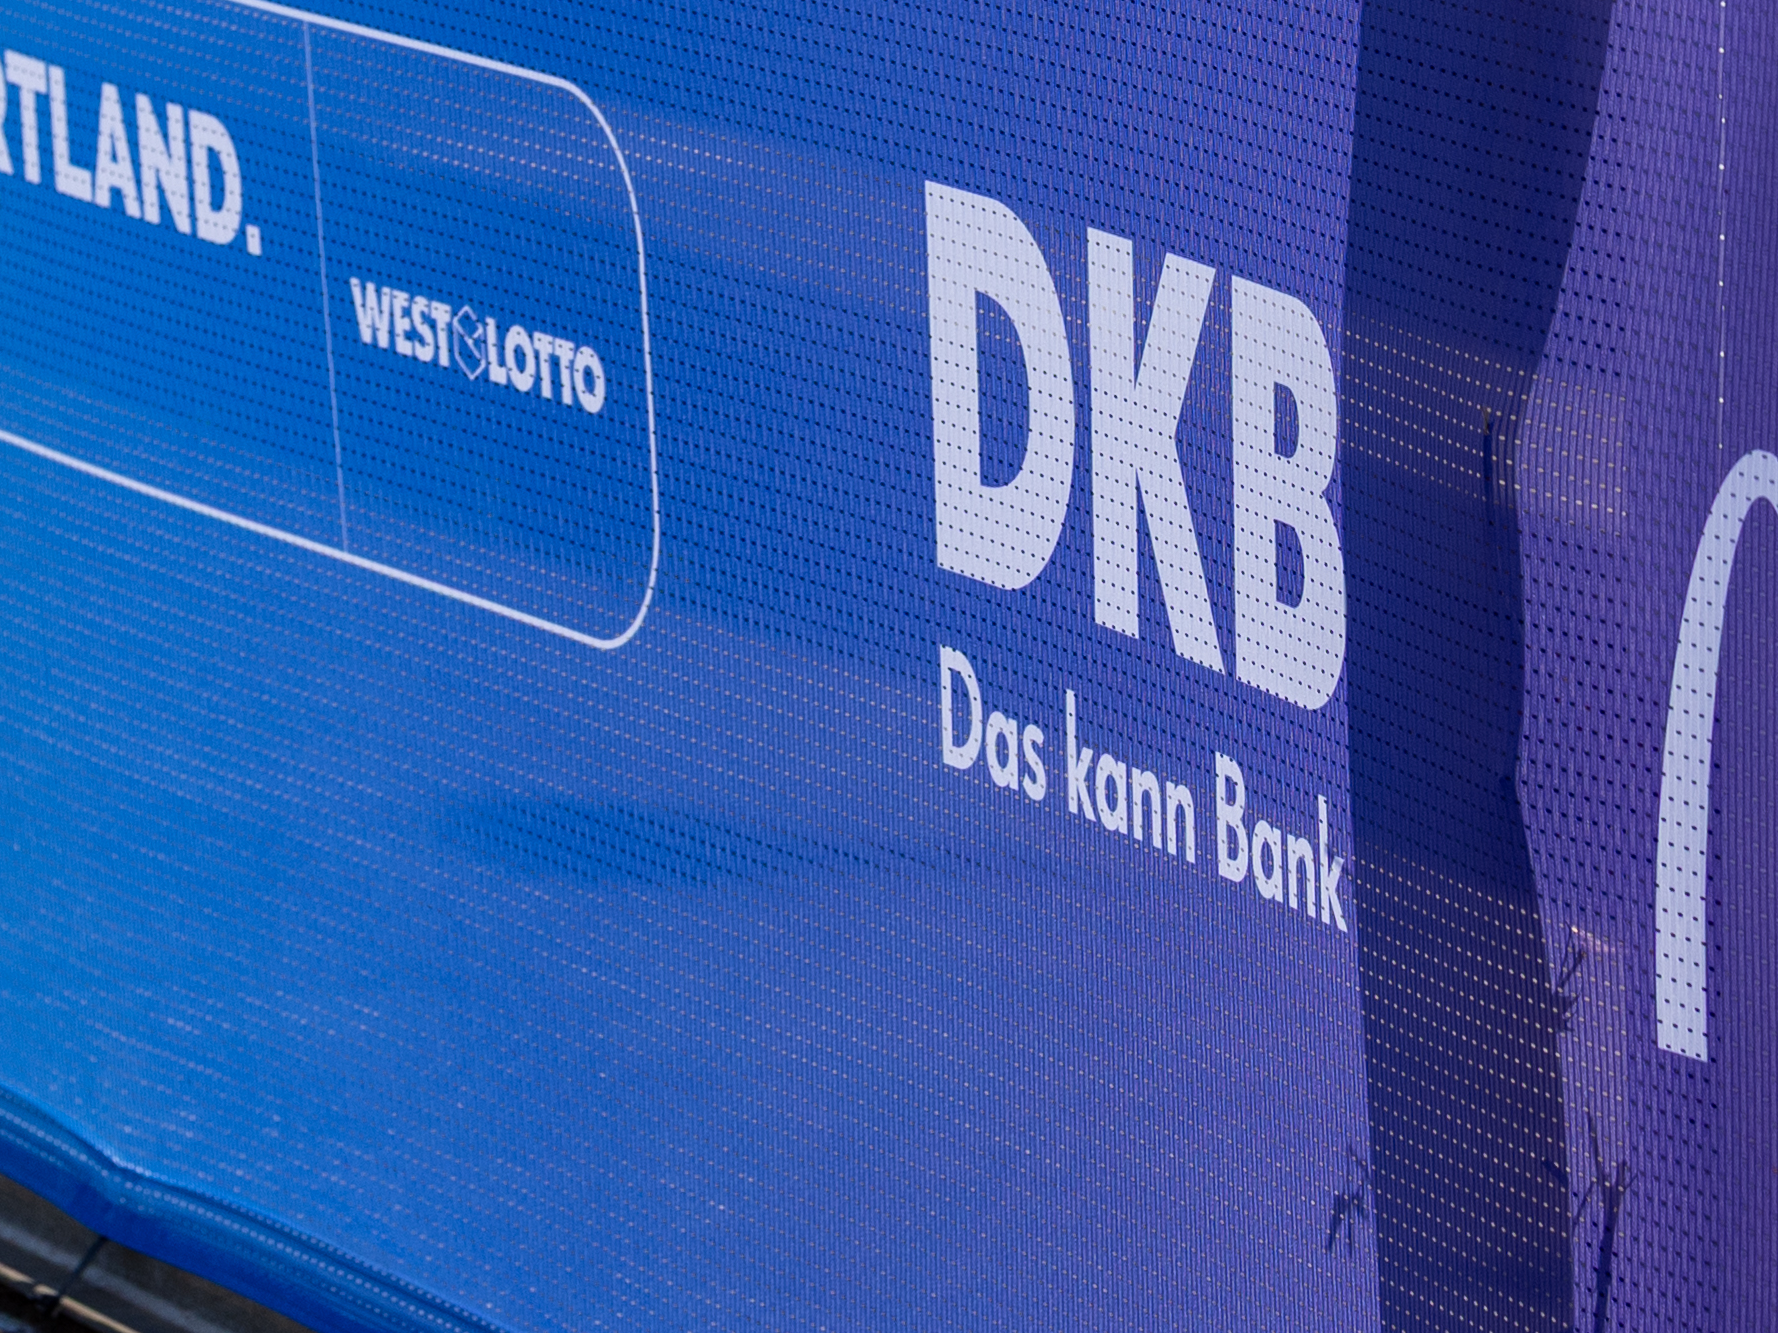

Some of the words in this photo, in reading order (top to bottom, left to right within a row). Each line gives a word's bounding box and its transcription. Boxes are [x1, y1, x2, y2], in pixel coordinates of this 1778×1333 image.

[924, 179, 1348, 712] DKB
[939, 644, 1047, 802] Das
[1065, 689, 1197, 864] kann
[1214, 751, 1349, 933] Bank
